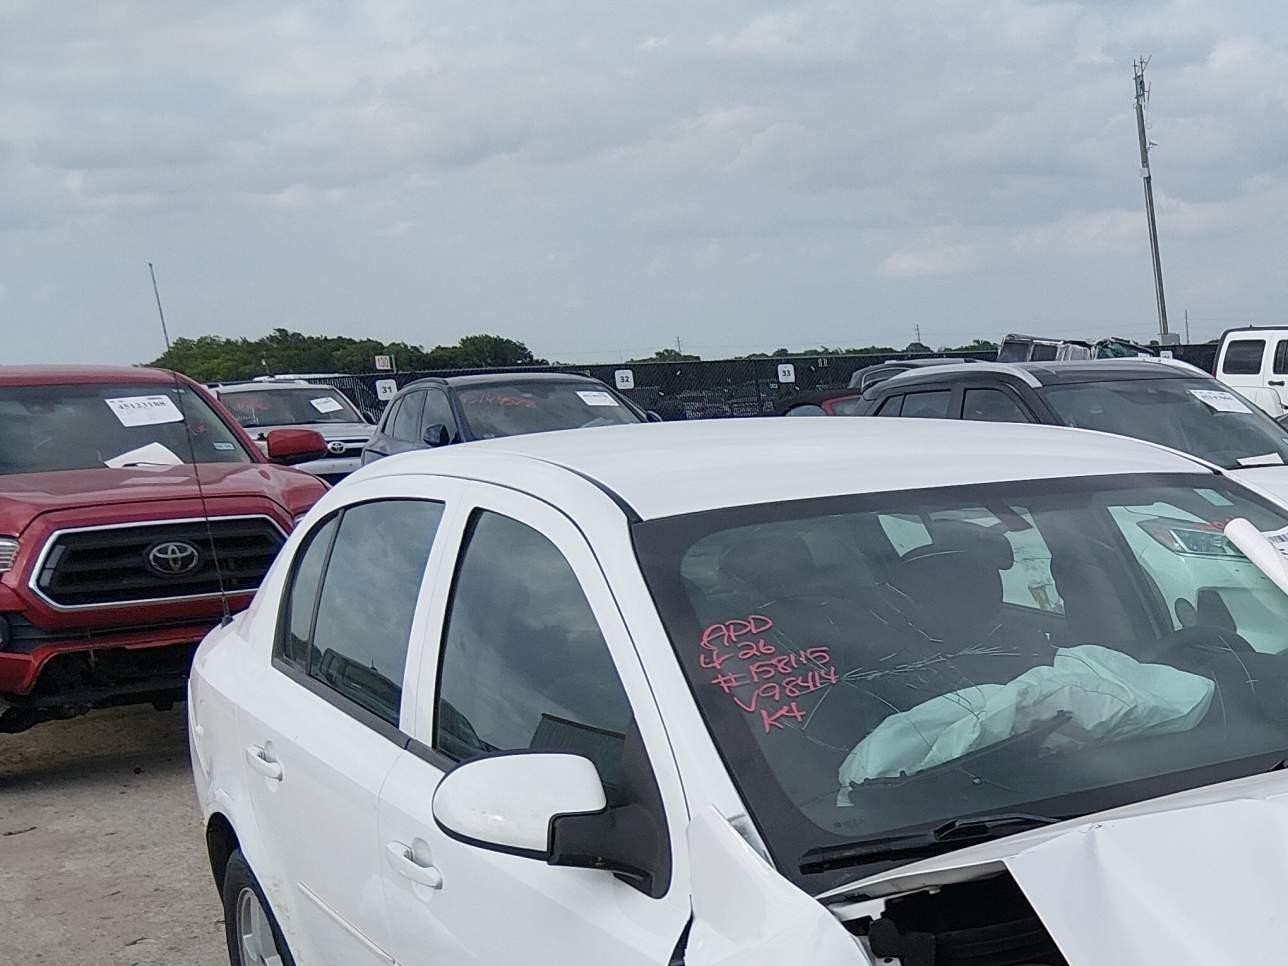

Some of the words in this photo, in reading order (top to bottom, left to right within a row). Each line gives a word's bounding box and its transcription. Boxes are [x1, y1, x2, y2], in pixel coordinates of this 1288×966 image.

[781, 369, 792, 378] 33
[619, 375, 630, 384] 32
[381, 385, 393, 395] 31
